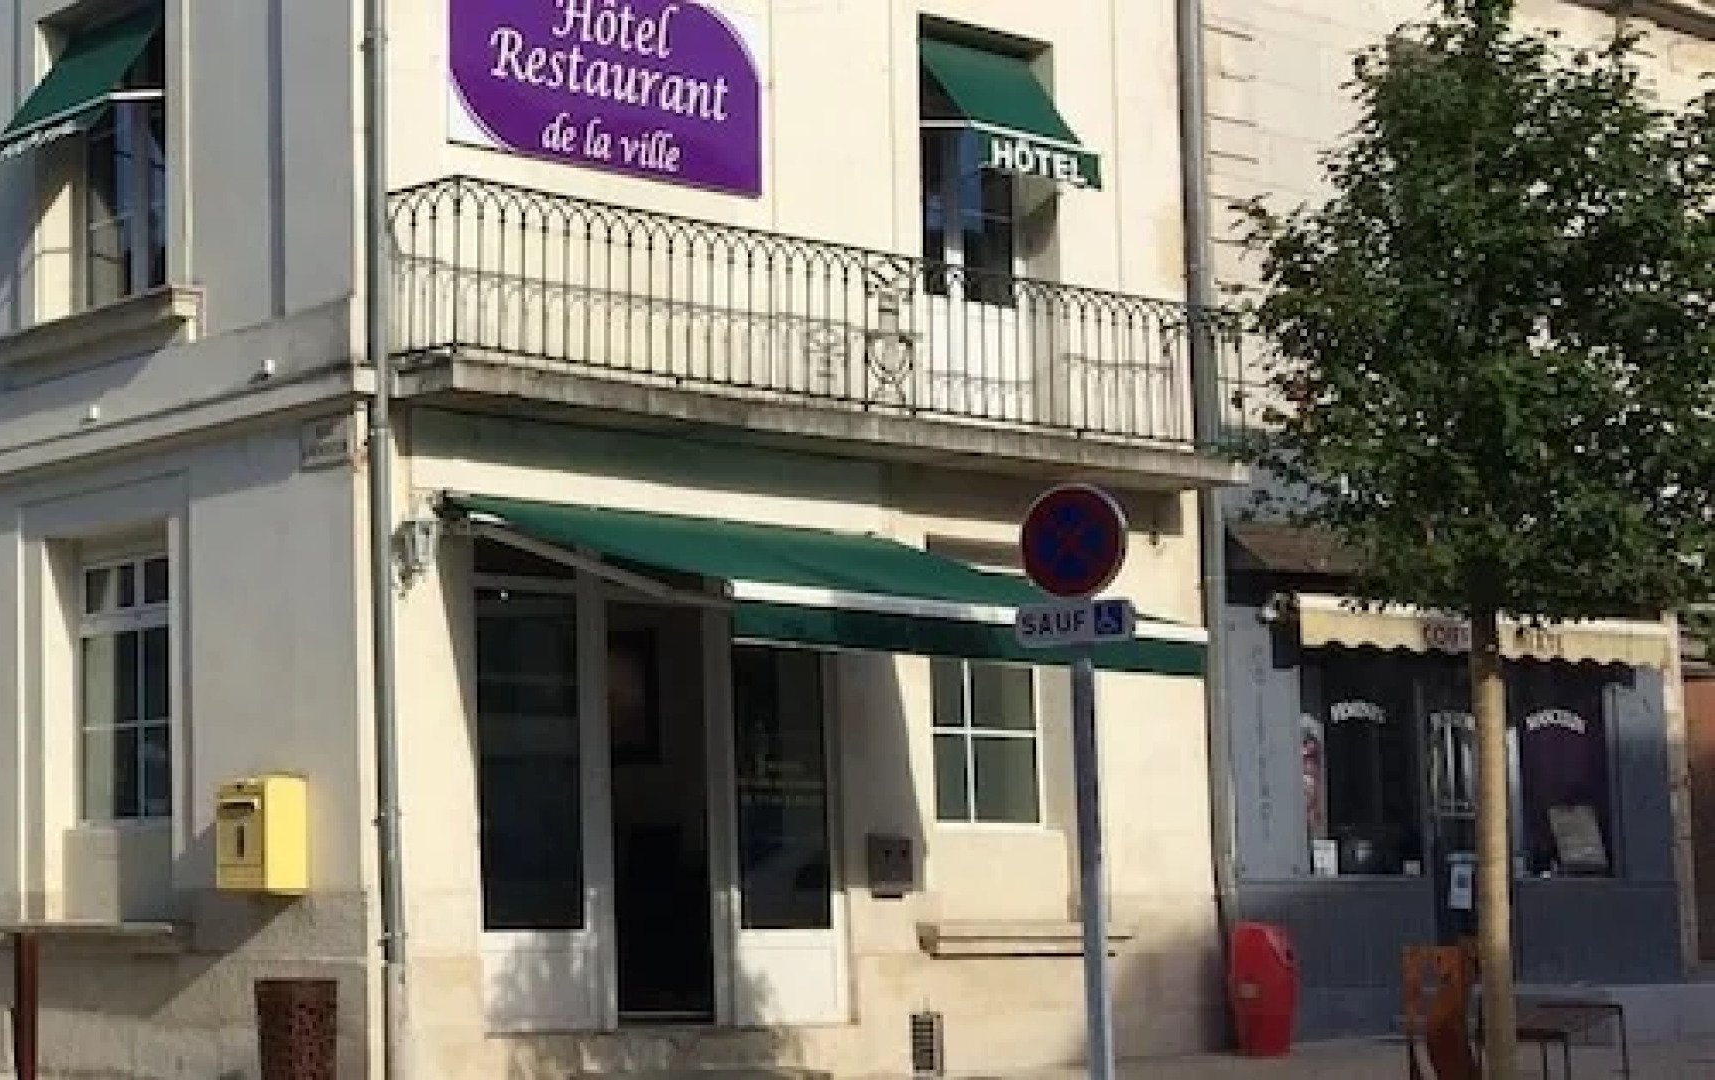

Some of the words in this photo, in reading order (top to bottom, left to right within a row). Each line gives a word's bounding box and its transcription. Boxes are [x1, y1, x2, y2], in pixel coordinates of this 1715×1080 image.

[552, 0, 680, 58] Hôtel
[490, 27, 729, 121] Restaurant
[542, 113, 577, 152] de
[583, 117, 612, 160] la
[621, 129, 681, 172] ville
[1022, 609, 1085, 635] SAUF
